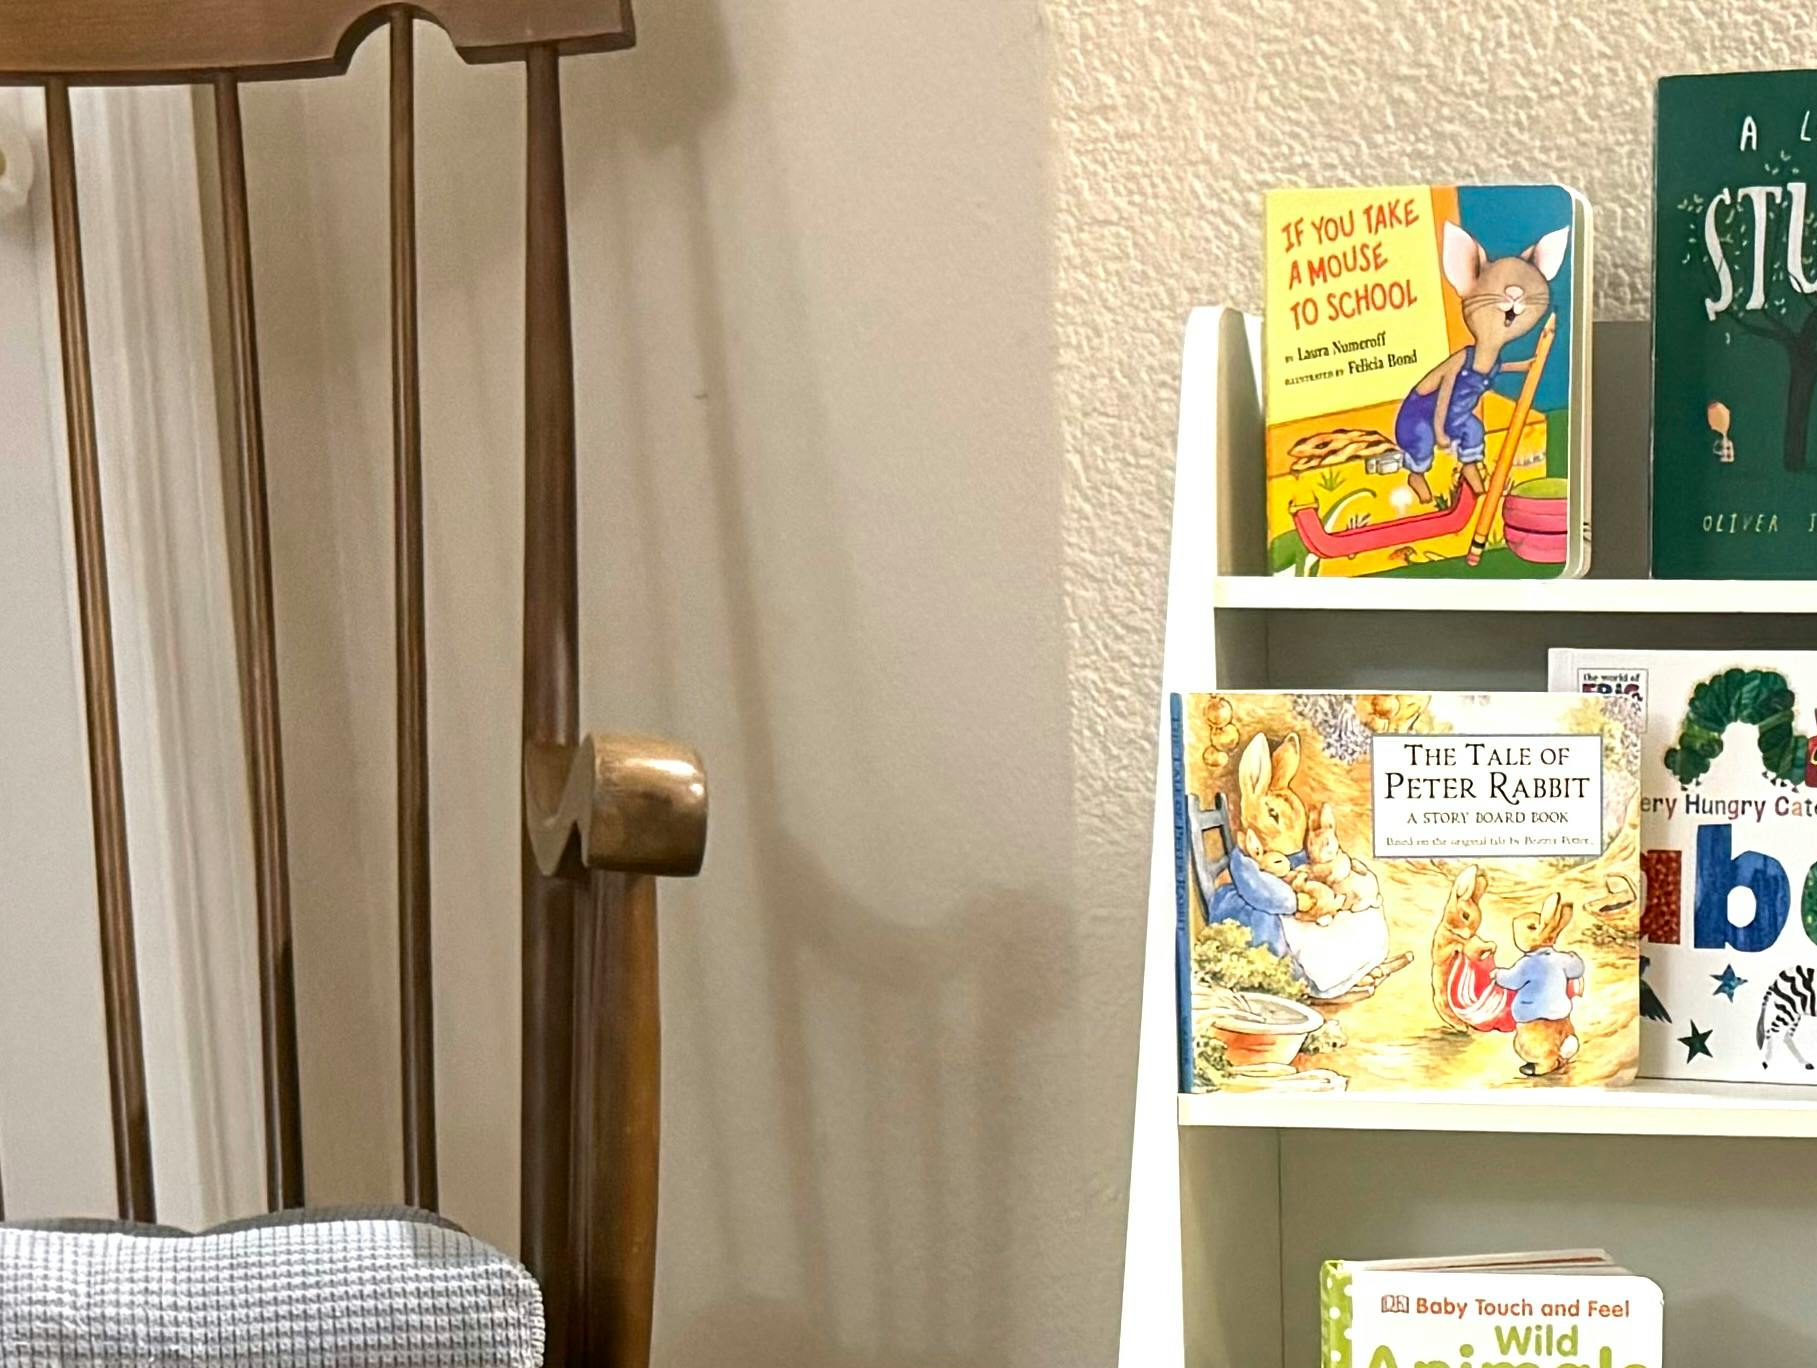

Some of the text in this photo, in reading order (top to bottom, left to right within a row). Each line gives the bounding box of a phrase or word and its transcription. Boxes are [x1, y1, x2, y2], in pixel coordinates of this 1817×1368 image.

[1739, 115, 1758, 151] A
[1282, 199, 1420, 253] IF YOU TAKE
[1289, 242, 1388, 290] A MOUSE
[1290, 280, 1417, 330] TO SCHOOL
[1298, 330, 1386, 360] Laura Numeroff
[1348, 349, 1417, 374] Felicia Bond
[1702, 514, 1780, 534] OLIVER
[1540, 748, 1570, 766] OF
[1407, 812, 1569, 824] A STORY BOARD BOOK
[1685, 794, 1766, 823] Hungry
[1416, 1297, 1629, 1319] Baby Touch and Feel
[1494, 1324, 1579, 1356] Wild
